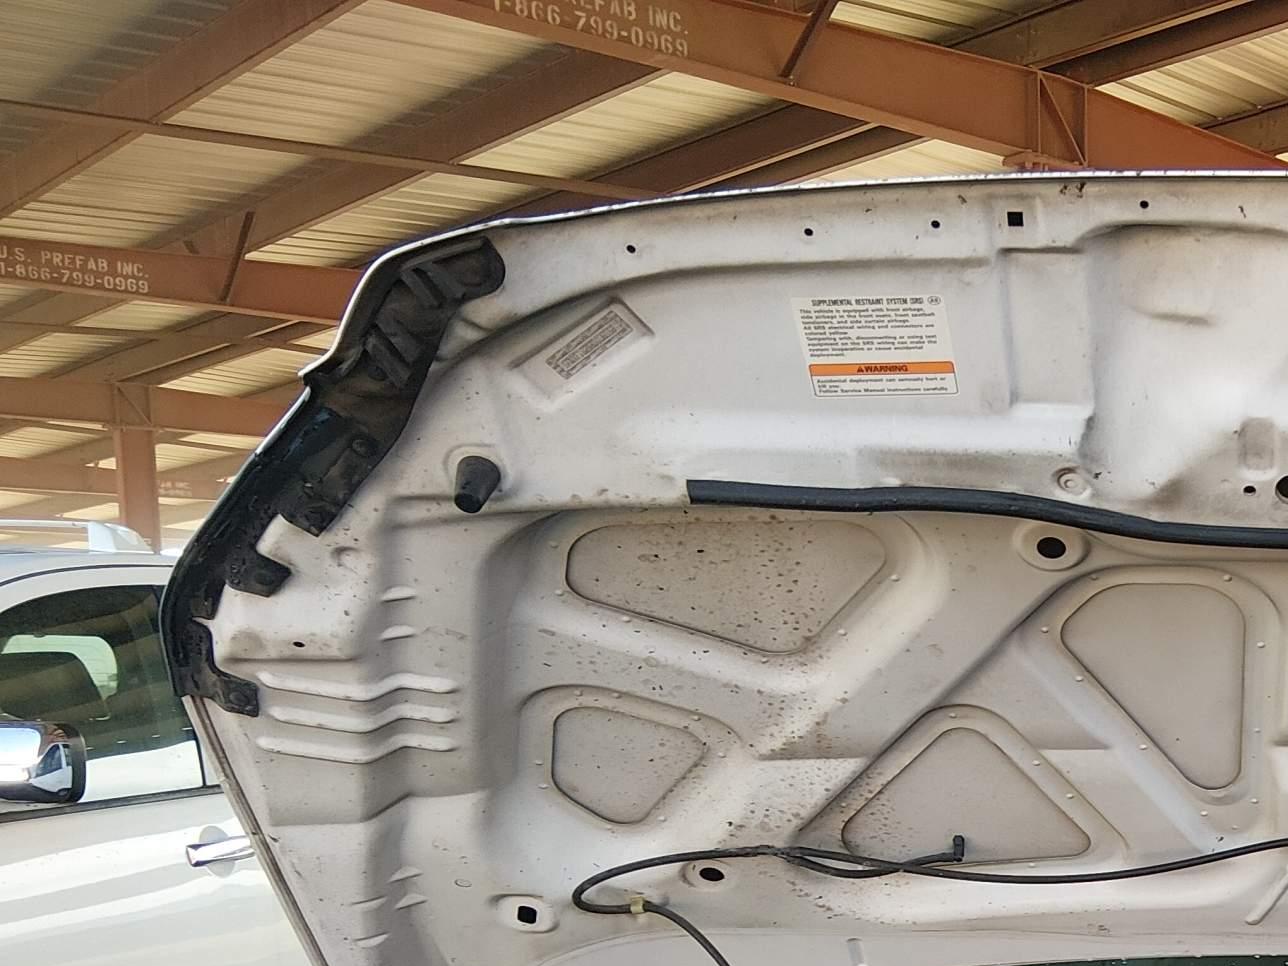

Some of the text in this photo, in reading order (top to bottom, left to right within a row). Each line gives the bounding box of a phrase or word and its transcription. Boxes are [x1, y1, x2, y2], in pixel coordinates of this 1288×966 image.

[493, 0, 688, 57] 1-866-799-0969
[648, 5, 688, 35] INC.
[0, 245, 149, 278] U.S. PREFAB INC.
[0, 262, 149, 293] 1-866-799-0969
